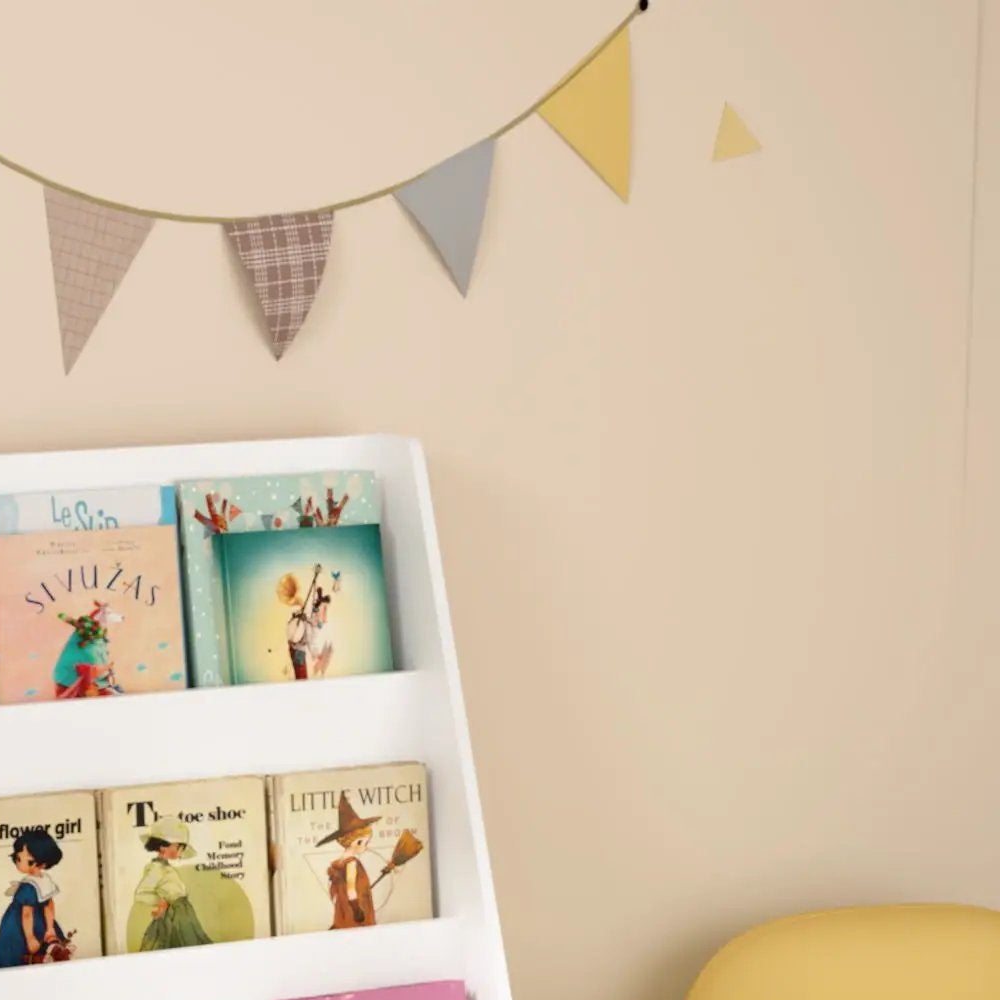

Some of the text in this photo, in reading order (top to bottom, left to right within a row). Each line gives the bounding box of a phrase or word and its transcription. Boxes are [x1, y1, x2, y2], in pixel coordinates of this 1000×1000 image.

[51, 495, 71, 528] Le
[358, 783, 422, 805] WITCH
[55, 818, 82, 839] girl
